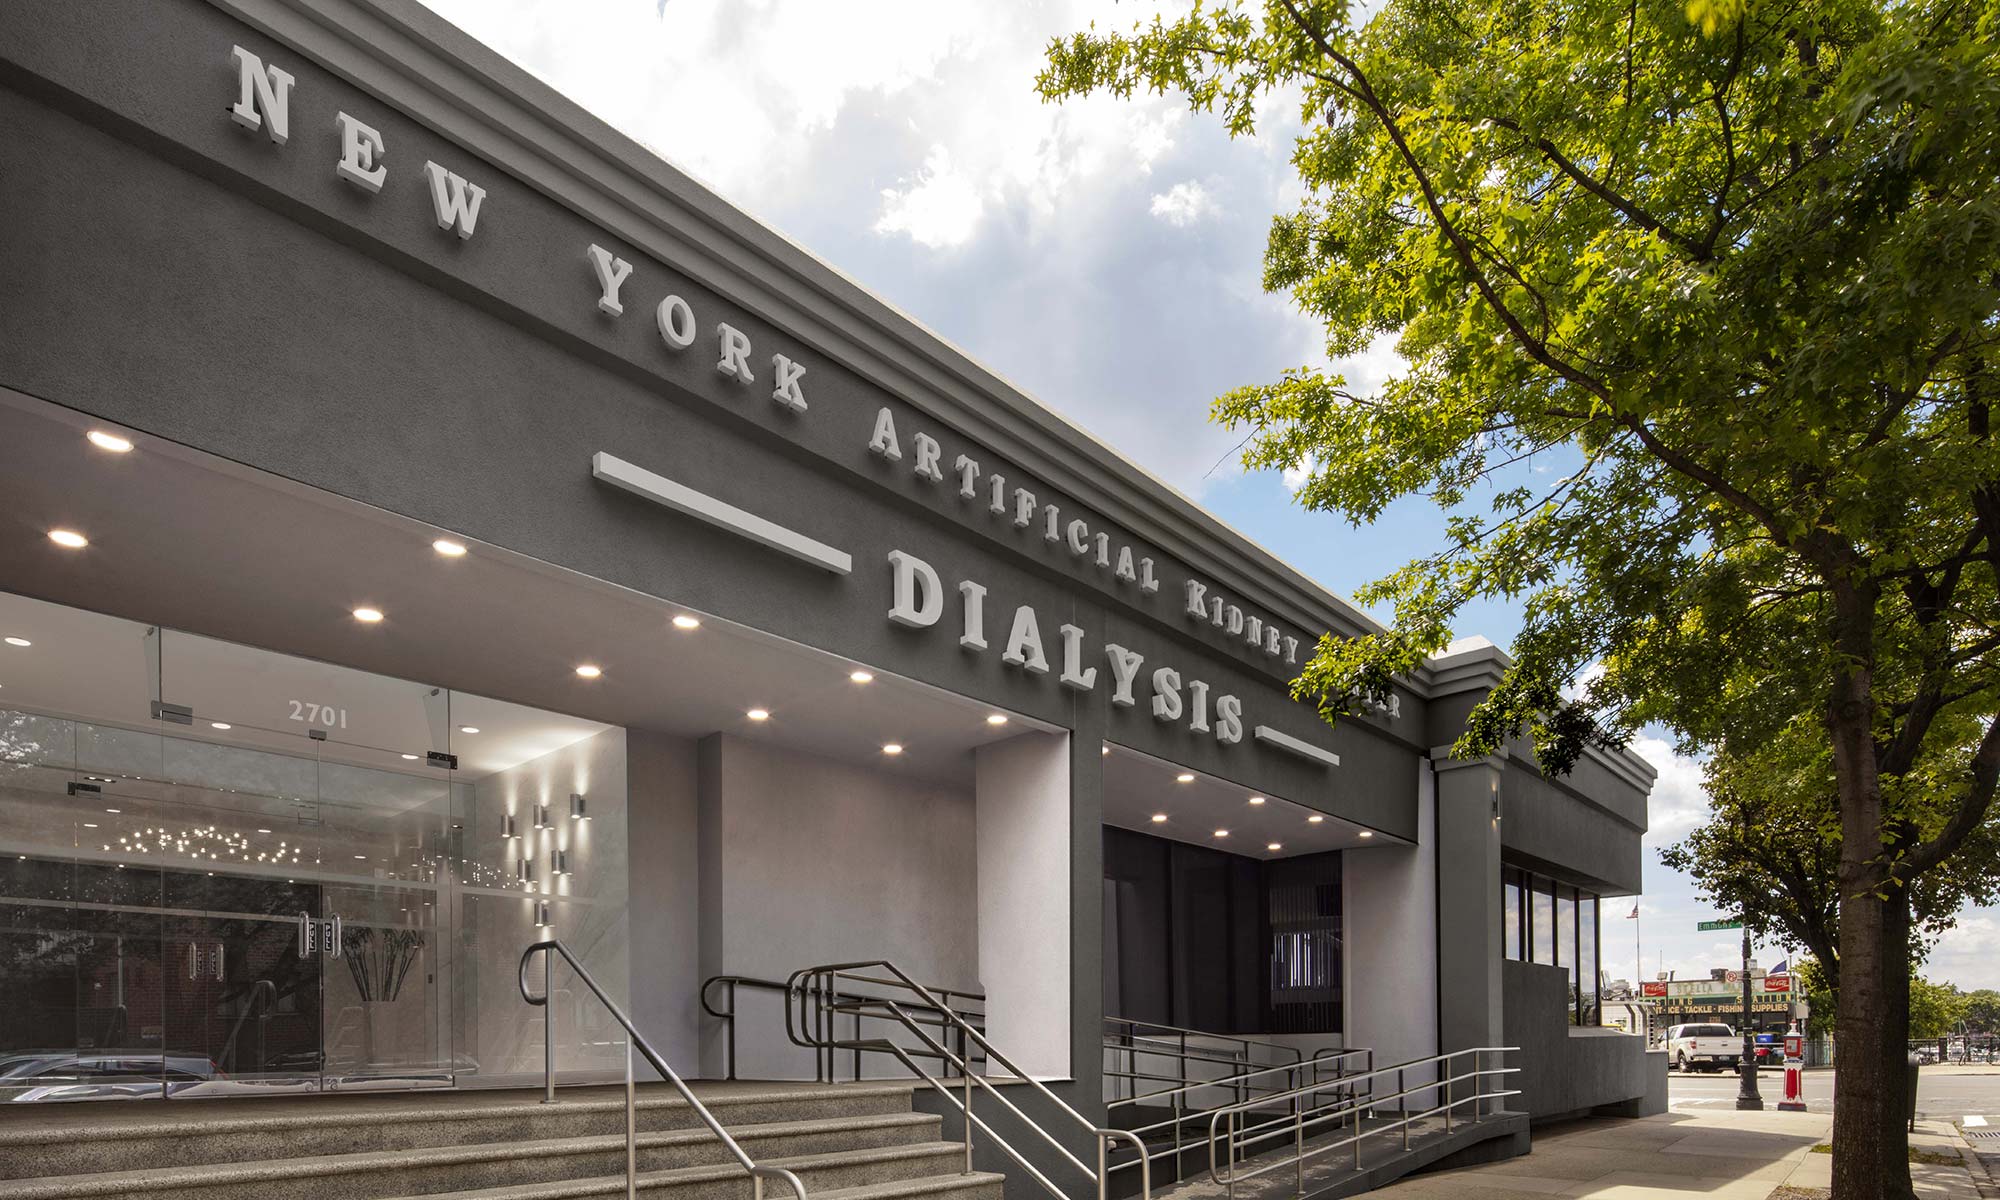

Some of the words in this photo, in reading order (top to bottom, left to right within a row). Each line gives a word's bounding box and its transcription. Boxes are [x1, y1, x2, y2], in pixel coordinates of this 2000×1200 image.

[231, 44, 487, 240] NEW
[587, 243, 808, 412] YORK
[868, 406, 1160, 594] ARTIFICIAL
[1186, 578, 1300, 665] KIDNEY
[888, 549, 1243, 744] DIALYSIS
[289, 700, 346, 728] 2701
[1684, 1005, 1712, 1014] TACKLE
[1718, 1003, 1744, 1014] FISHIN
[1751, 1003, 1788, 1012] SUPPLIES
[1736, 993, 1791, 1004] SATION
